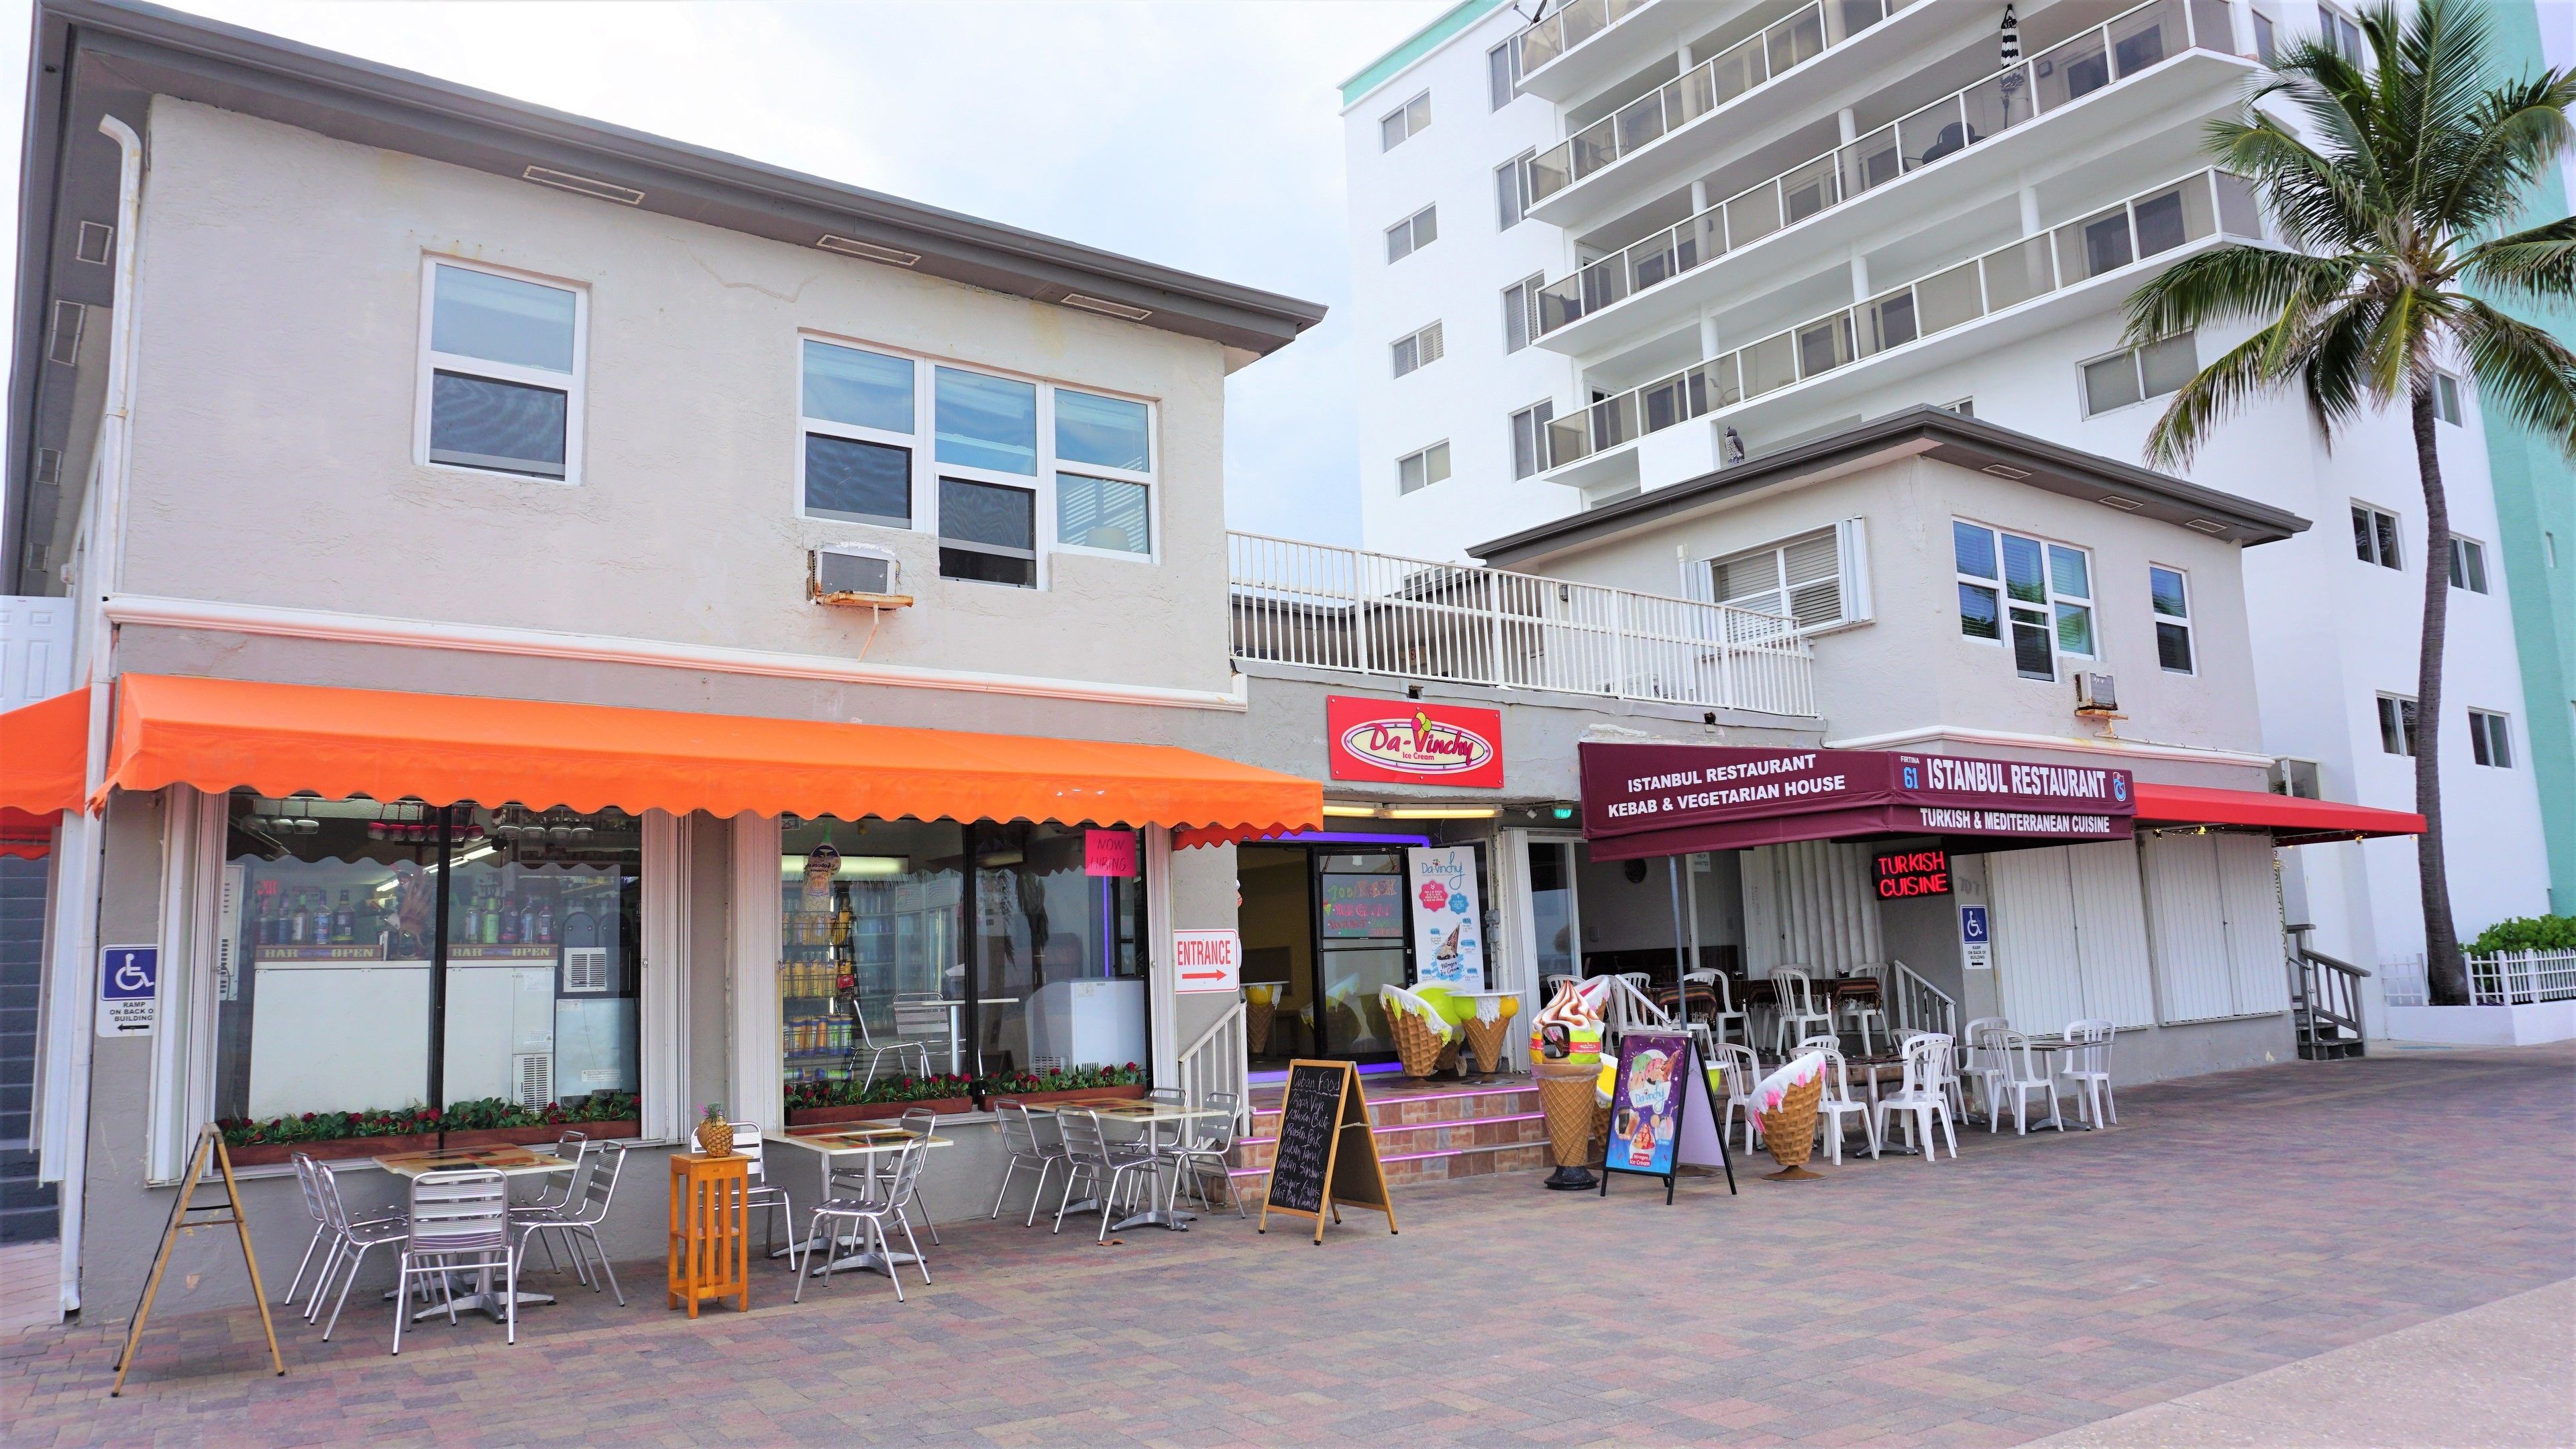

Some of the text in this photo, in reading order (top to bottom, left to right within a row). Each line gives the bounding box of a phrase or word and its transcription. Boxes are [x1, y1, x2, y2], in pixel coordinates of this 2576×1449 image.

[1402, 751, 1434, 761] Ice Cream
[1900, 755, 1920, 764] FIRTINA
[1628, 753, 1816, 793] ISTANBUL RESTAURANT
[1903, 766, 1919, 789] 61
[1927, 758, 2106, 798] ISTANBUL RESTAURANT
[1608, 775, 1845, 818] KEBAB & VEGETARIAN HOUSE
[1920, 808, 2110, 833] TURKISH & MEDITERRANEAN CUISINE
[1097, 838, 1125, 851] NOW
[1091, 856, 1127, 871] HIRING
[1878, 851, 1945, 875] TURKISH
[1880, 873, 1948, 897] CUISINE
[264, 948, 374, 958] BAR OPEN
[451, 948, 550, 957] BAR OPEN
[1177, 940, 1231, 965] ENTRANCE
[1293, 1068, 1340, 1092] Cuban Food
